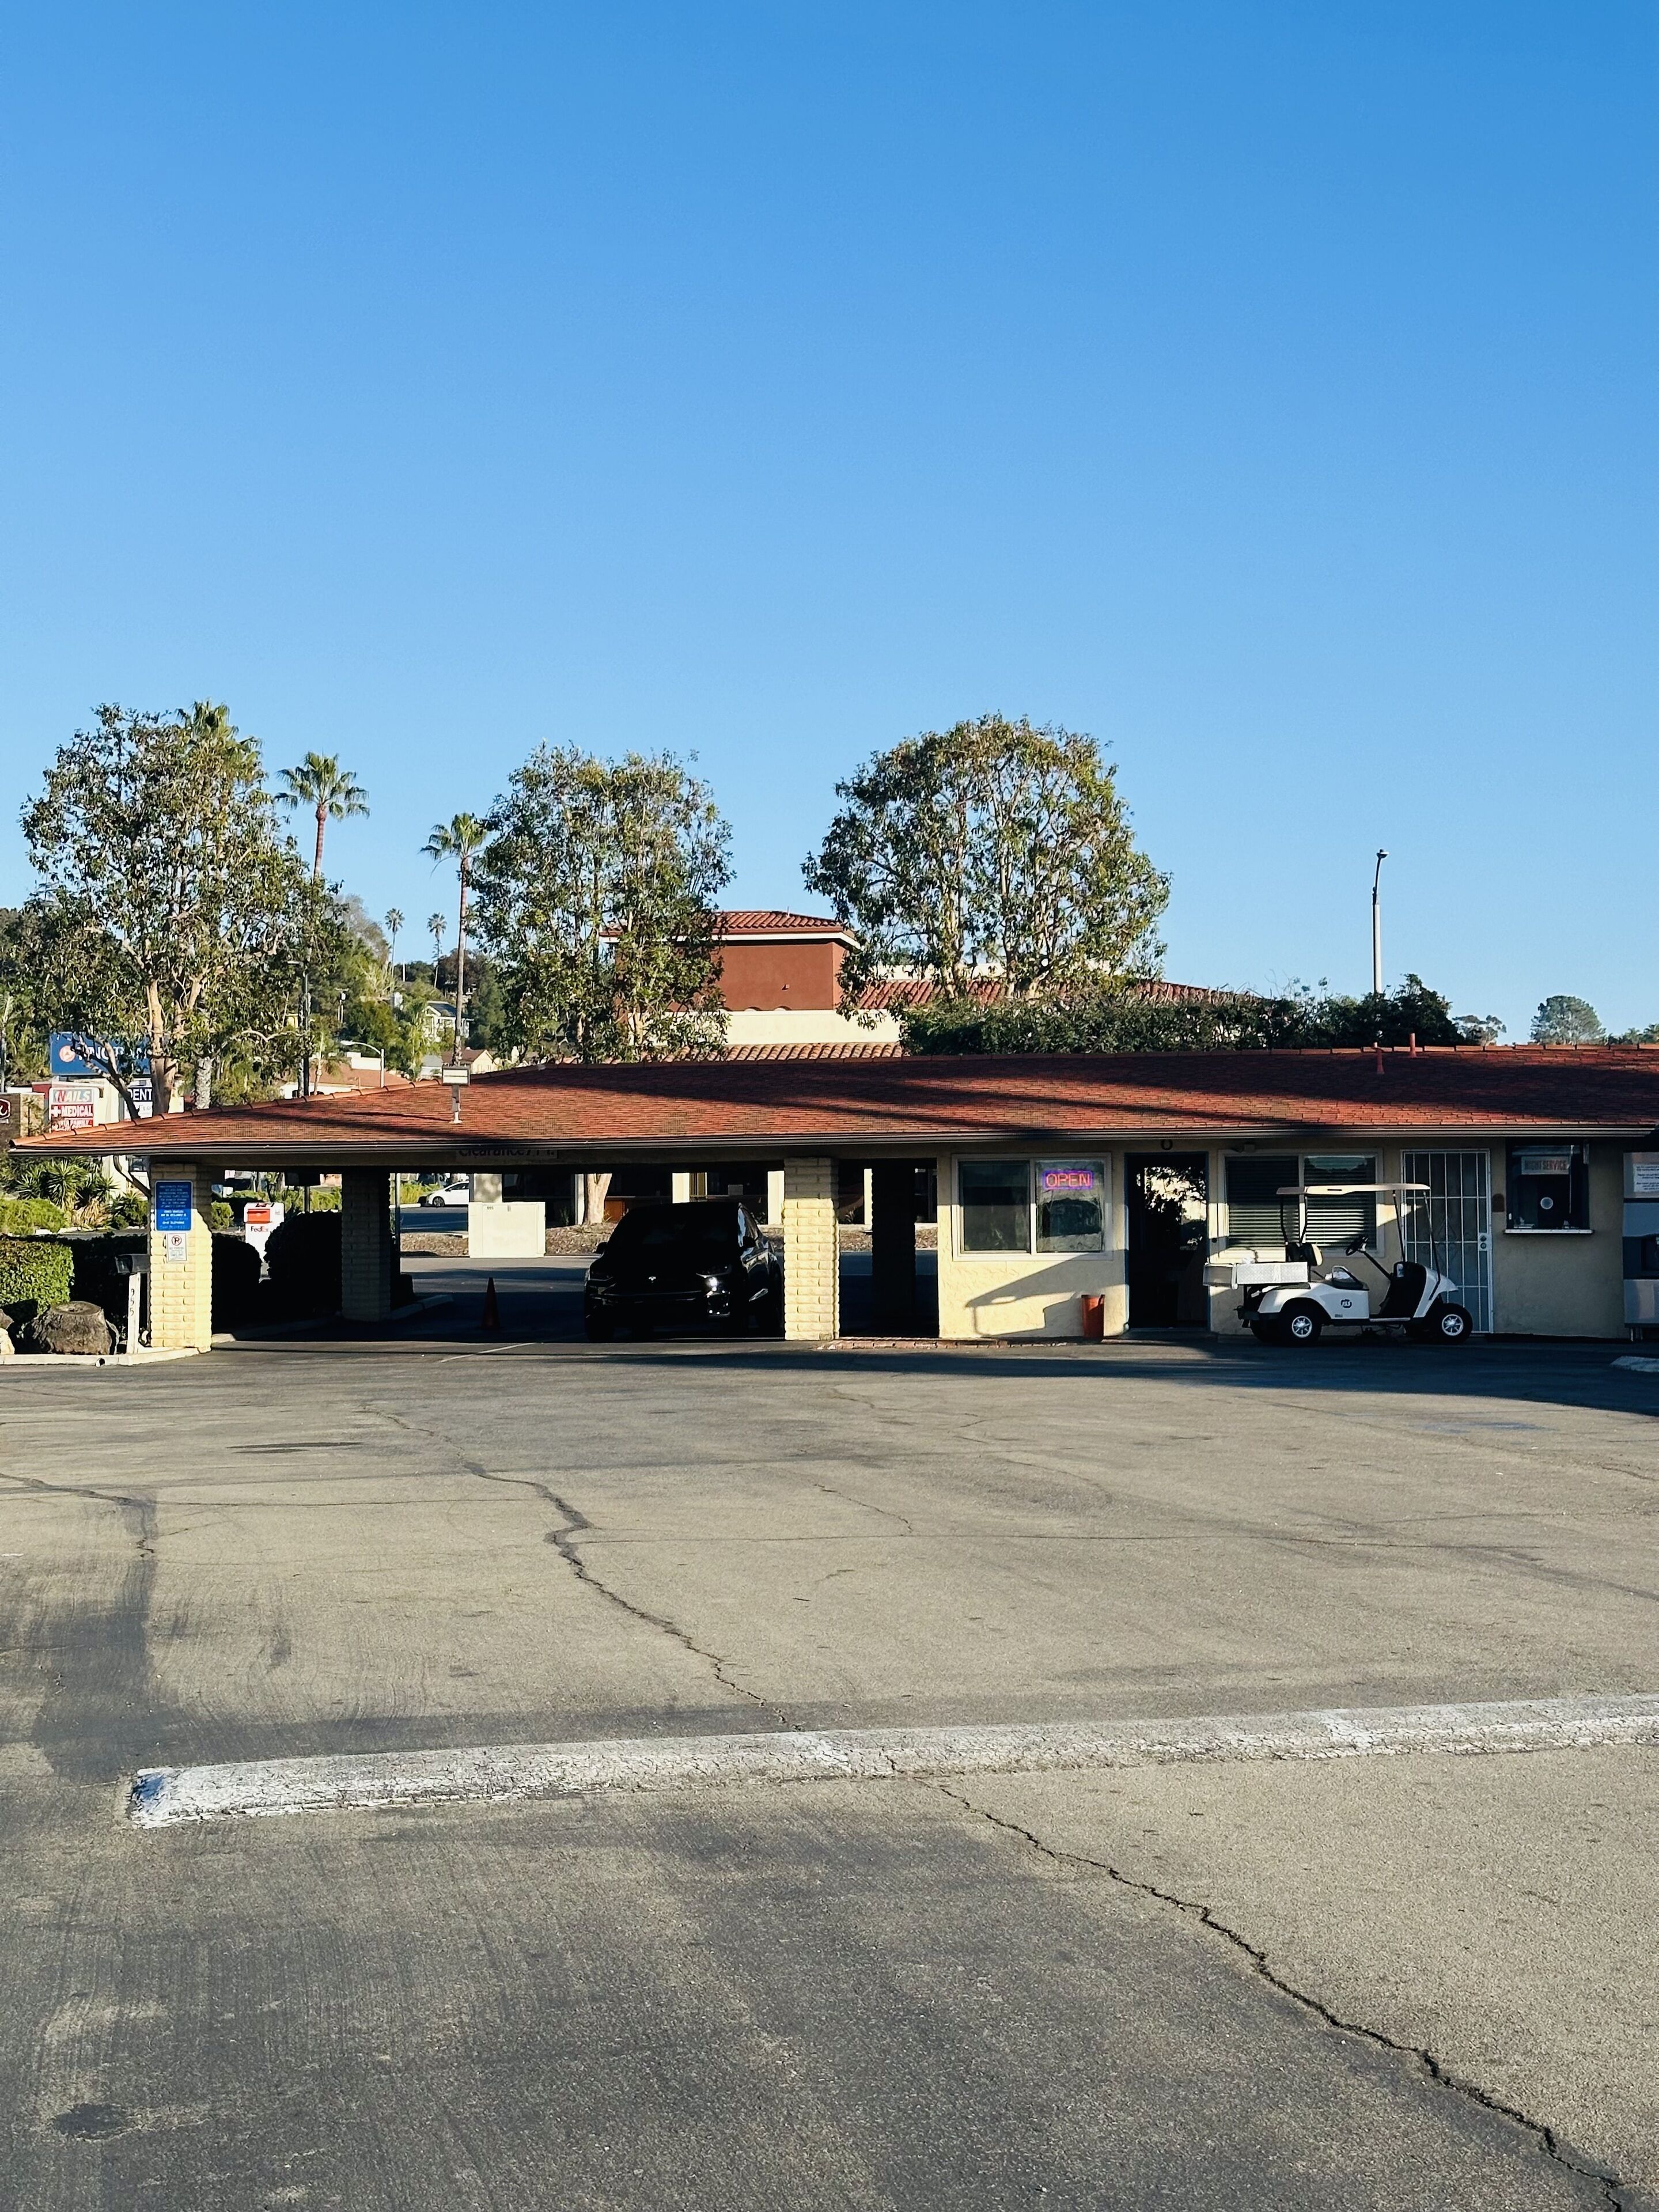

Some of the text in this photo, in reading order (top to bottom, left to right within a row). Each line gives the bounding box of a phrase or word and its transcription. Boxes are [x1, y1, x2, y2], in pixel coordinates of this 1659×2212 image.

[56, 1090, 91, 1102] NAILS
[61, 1105, 93, 1117] MEDICAL
[1543, 1160, 1567, 1171] SERVICE
[1046, 1173, 1090, 1187] OPEN
